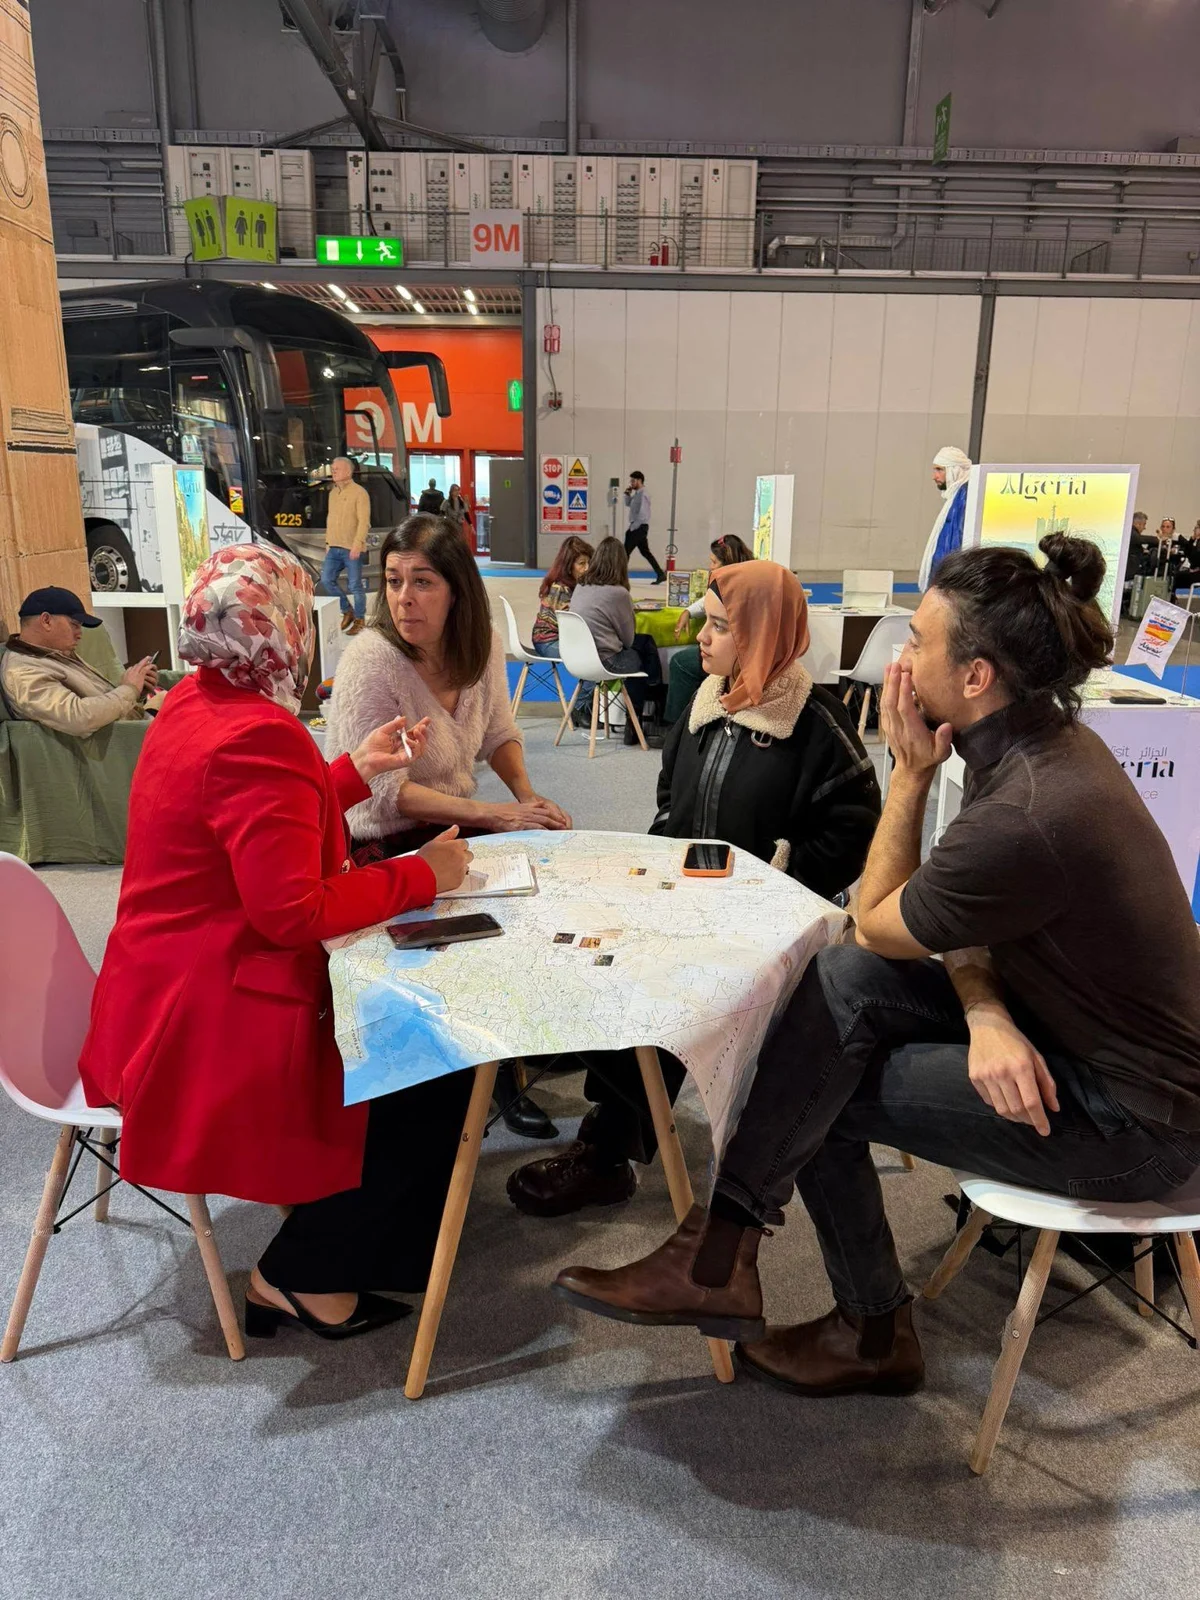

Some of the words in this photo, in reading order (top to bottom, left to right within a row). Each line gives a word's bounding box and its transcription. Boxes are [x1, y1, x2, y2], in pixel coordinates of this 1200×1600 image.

[473, 223, 520, 253] 9M
[543, 464, 562, 472] STOP
[1000, 472, 1086, 502] Algeria
[274, 512, 303, 526] 1225
